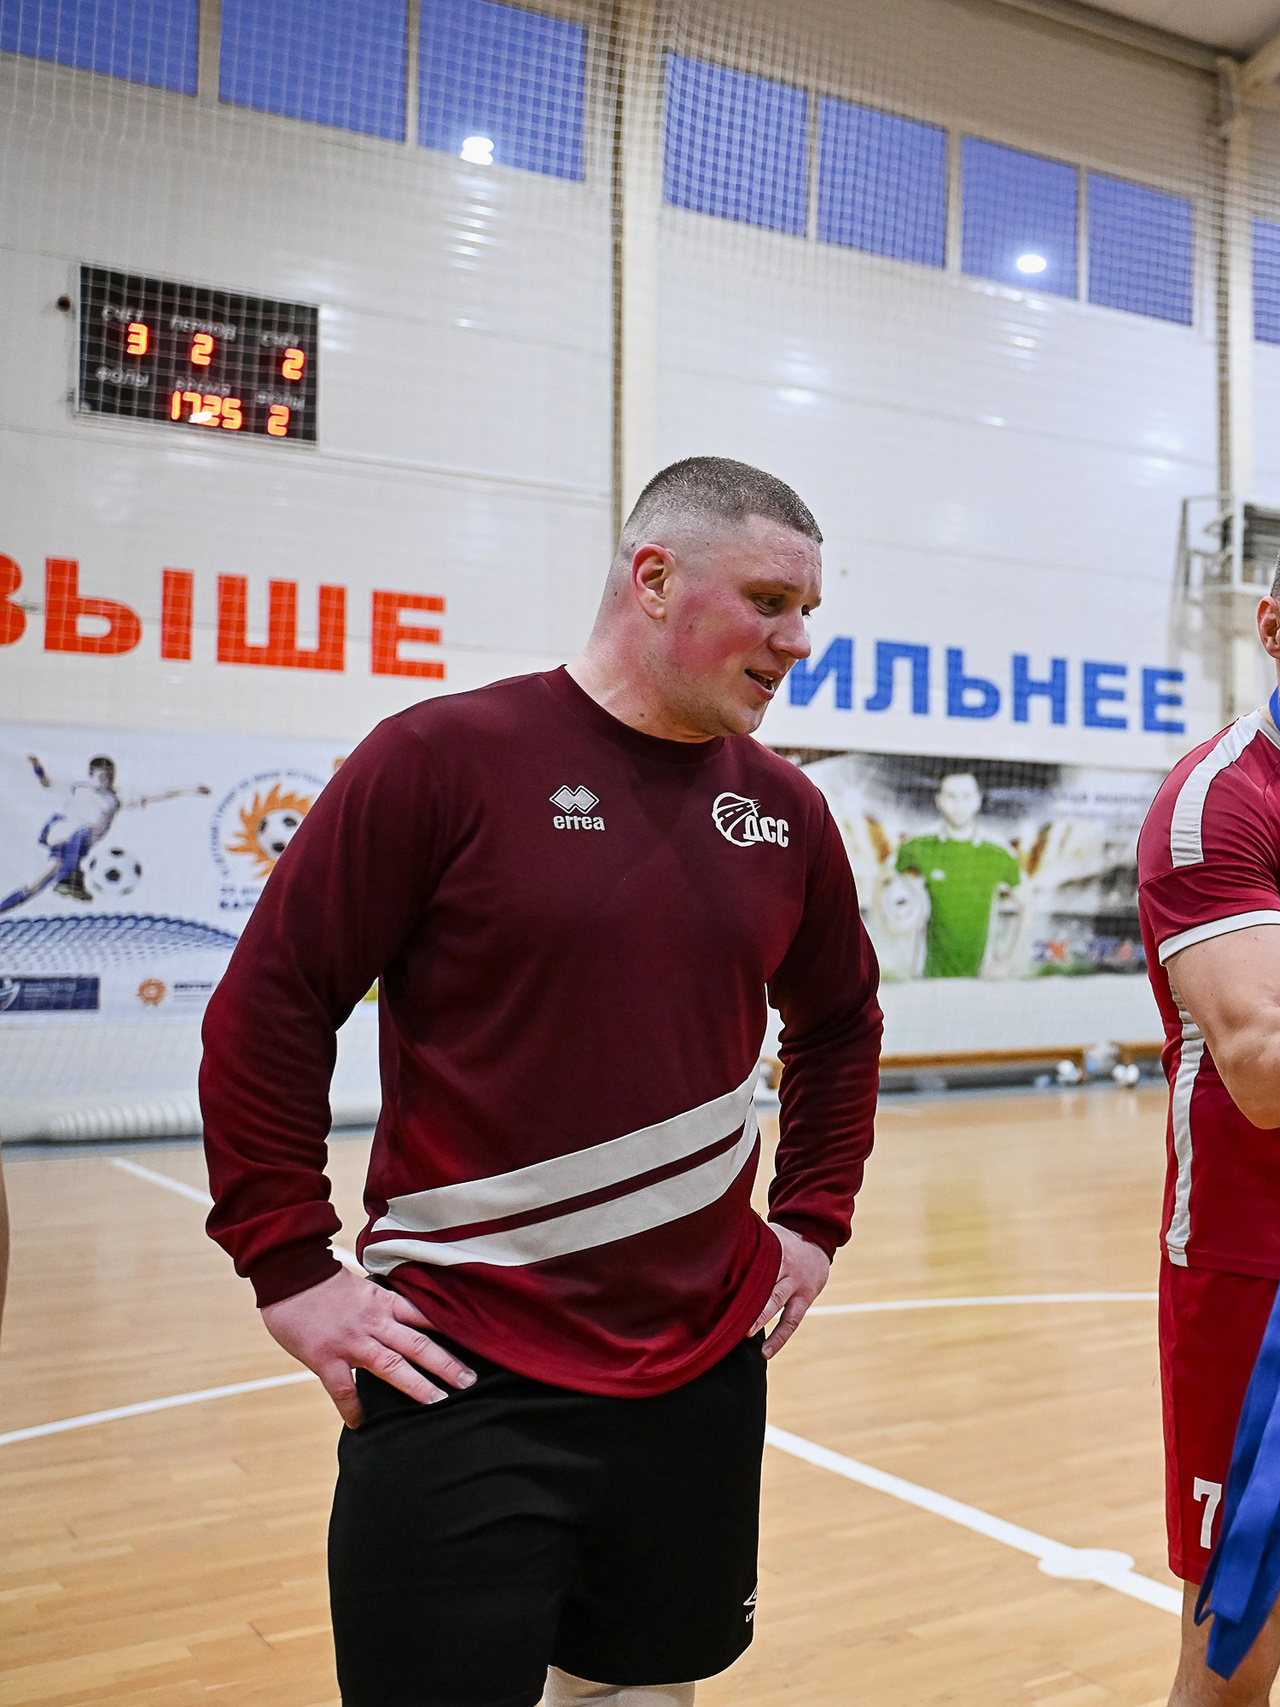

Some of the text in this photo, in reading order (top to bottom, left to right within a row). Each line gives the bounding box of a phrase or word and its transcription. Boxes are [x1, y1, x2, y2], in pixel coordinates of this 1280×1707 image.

[127, 322, 149, 355] 3
[191, 332, 214, 366] 2
[282, 348, 305, 380] 2
[267, 404, 290, 436] 2
[789, 636, 1186, 735] ИЛЬНЕЕ
[553, 815, 606, 831] errea
[742, 815, 790, 848] ДСС
[1193, 1476, 1222, 1549] 7
